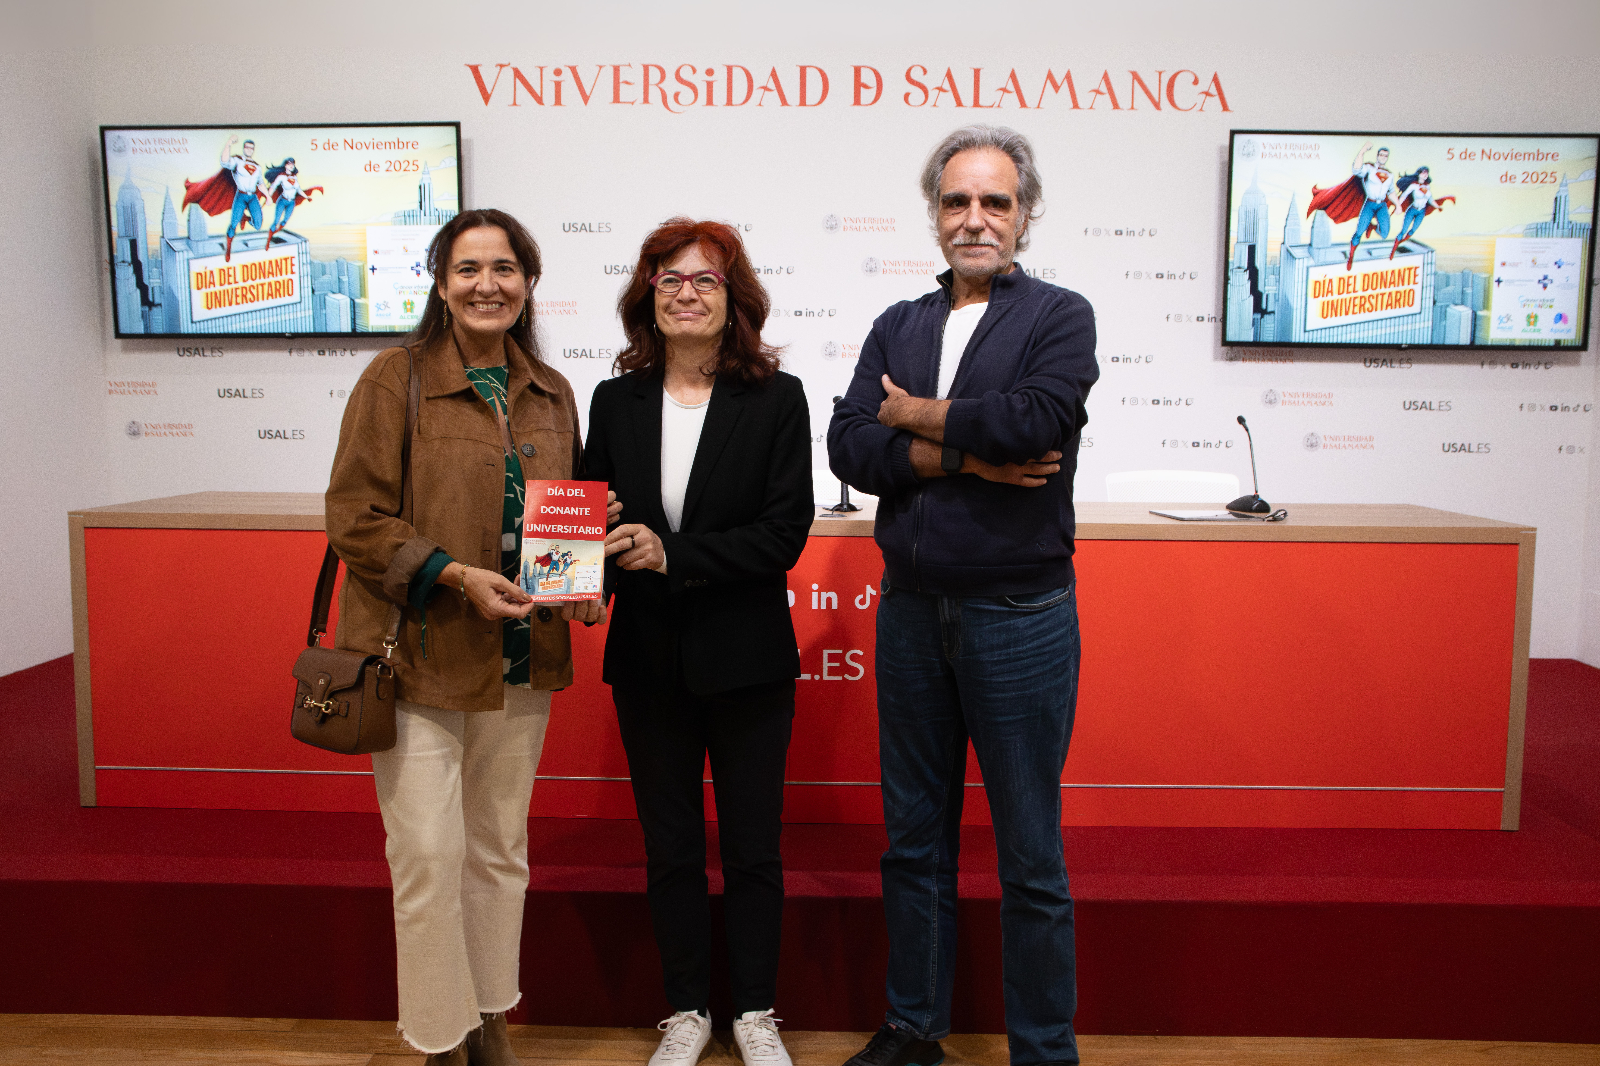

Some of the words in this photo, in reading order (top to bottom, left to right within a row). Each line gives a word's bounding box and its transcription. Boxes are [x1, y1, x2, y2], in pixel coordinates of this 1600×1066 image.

[903, 64, 1234, 113] SALAMANCA
[310, 138, 318, 151] 5
[322, 138, 339, 151] de
[343, 137, 419, 151] Noviembre
[1446, 147, 1455, 161] 5
[1459, 147, 1476, 161] de
[1481, 147, 1559, 161] Noviembre
[364, 159, 380, 172] de
[384, 159, 419, 172] 2025
[1500, 171, 1517, 184] de
[1521, 171, 1558, 184] 2025
[562, 222, 612, 233] USAL.ES
[195, 265, 215, 291] DÍA
[218, 266, 239, 287] DEL
[242, 256, 296, 283] DONANTE
[1312, 273, 1333, 299] DÍA
[1337, 275, 1358, 296] DEL
[1362, 266, 1420, 292] DONANTE
[205, 278, 294, 310] UNIVERSITARIO
[1321, 288, 1415, 320] UNIVERSITARIO
[176, 346, 224, 358] USAL.ES
[563, 348, 612, 359] USAL.ES
[1363, 357, 1413, 369] USAL.ES
[216, 387, 265, 399] USAL.ES
[1403, 400, 1452, 412] USAL.ES
[257, 429, 305, 440] USAL.ES
[1442, 442, 1491, 454] USAL.ES
[547, 486, 565, 497] DÍA
[567, 488, 586, 498] DEL
[540, 505, 591, 516] DONANTE
[526, 523, 603, 535] UNIVERSITARIO
